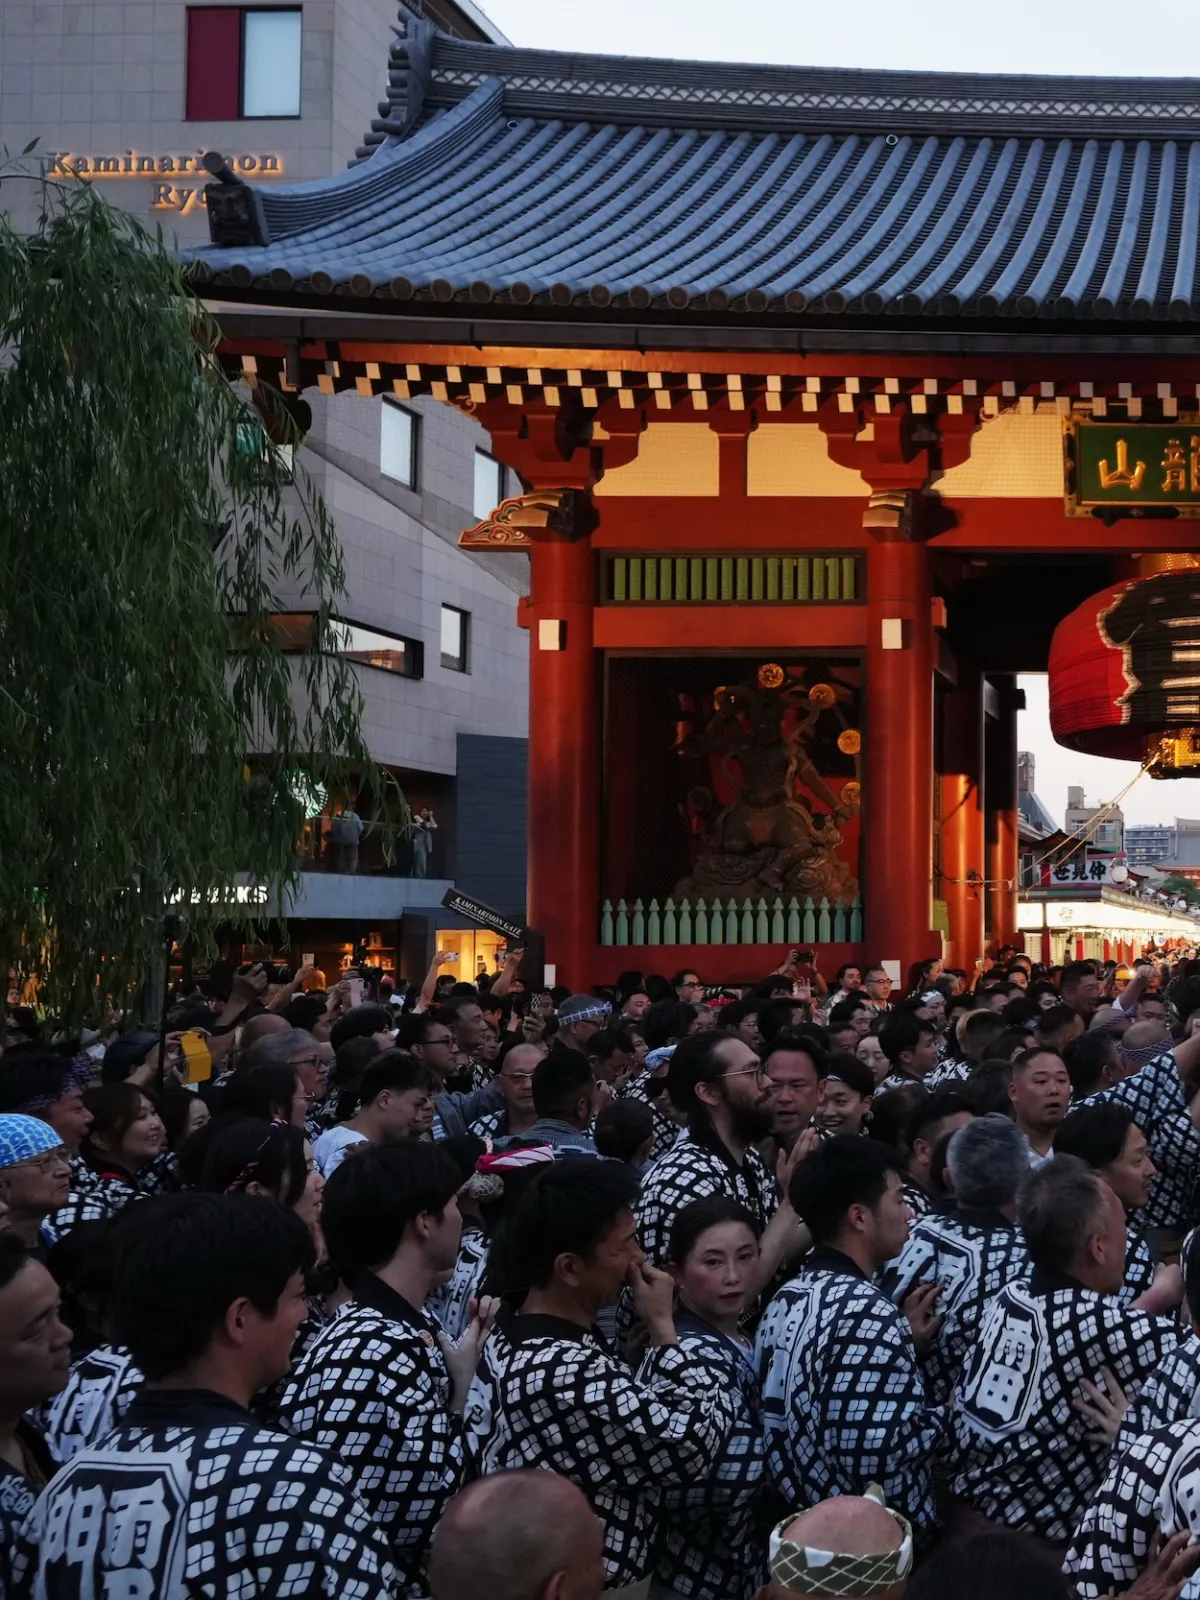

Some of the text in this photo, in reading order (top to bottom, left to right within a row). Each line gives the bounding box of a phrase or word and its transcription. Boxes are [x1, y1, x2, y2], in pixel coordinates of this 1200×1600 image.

[1053, 860, 1107, 881] 仲見世
[455, 896, 505, 929] KAMINARIMON
[503, 921, 523, 936] GATE
